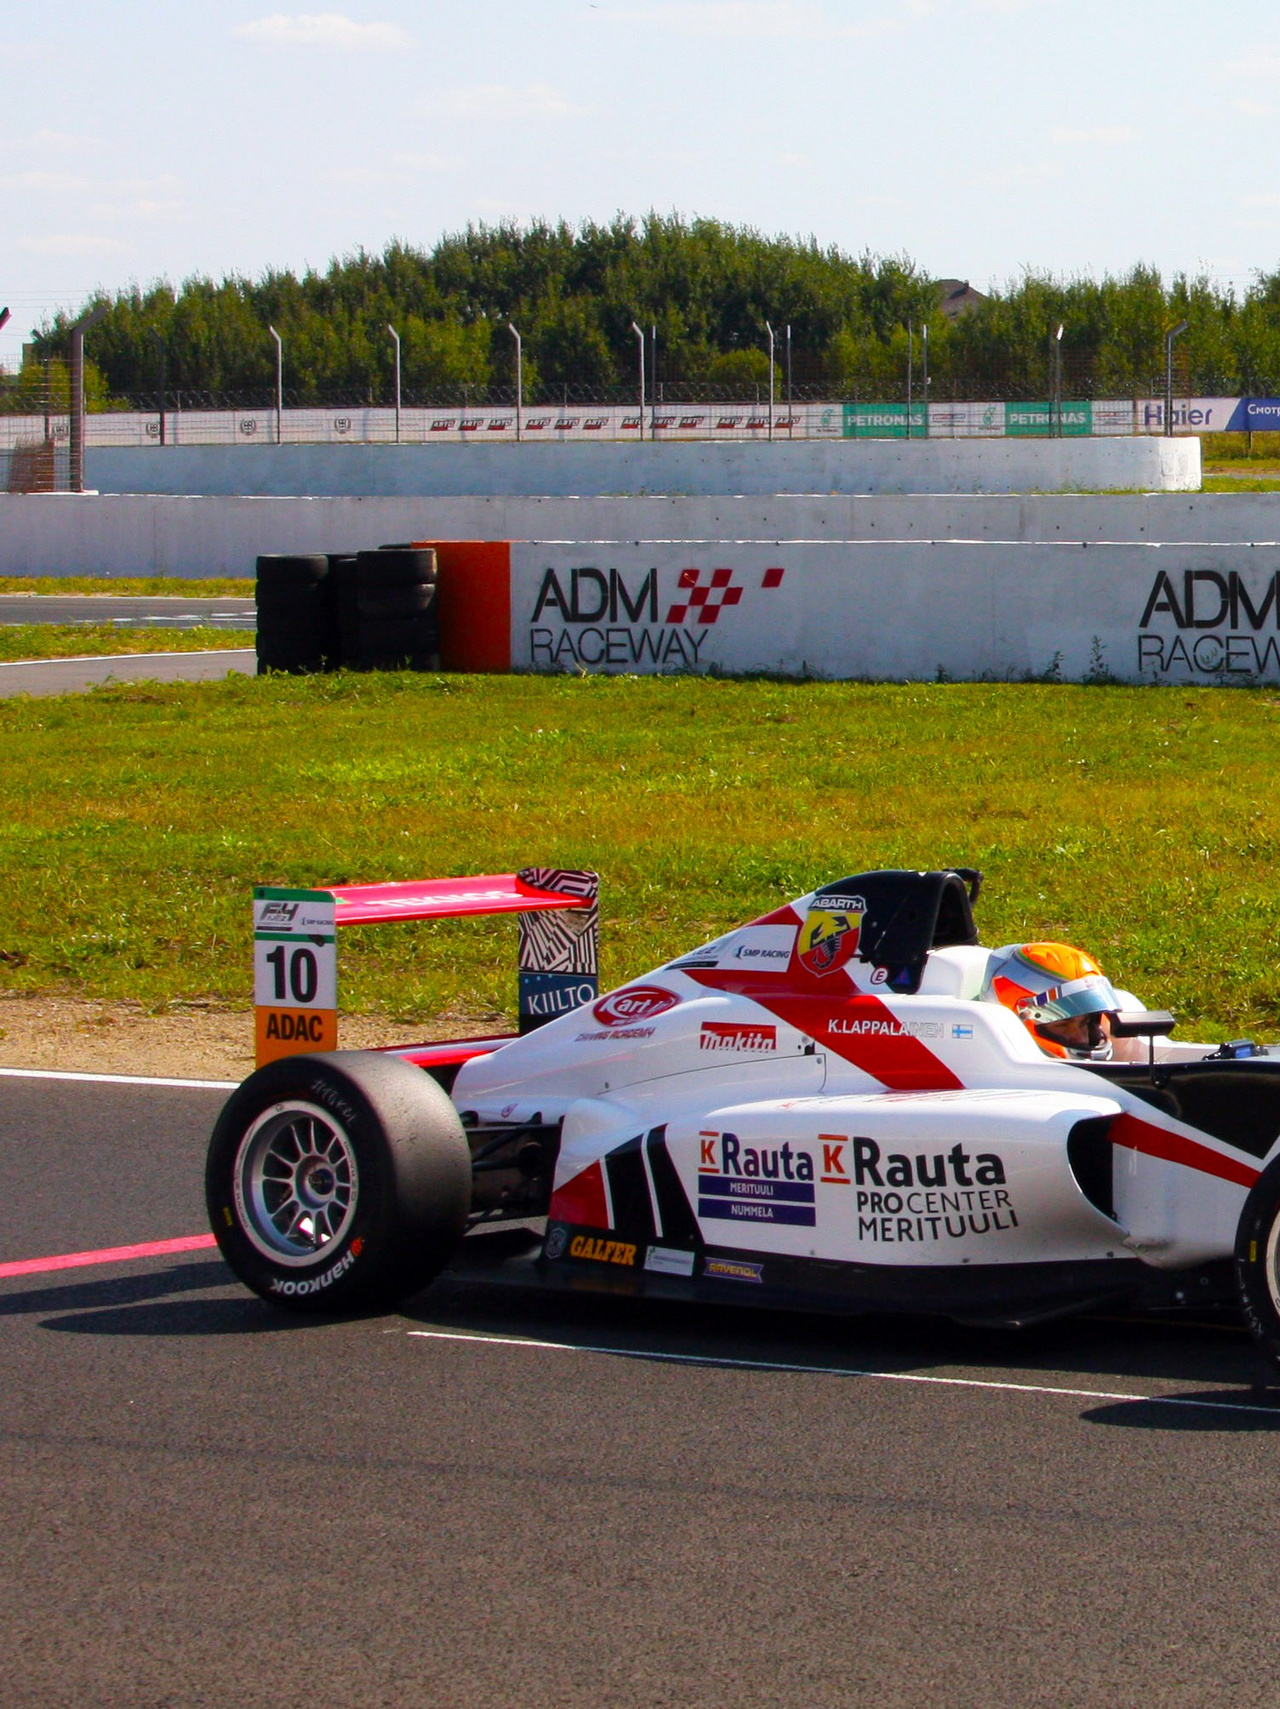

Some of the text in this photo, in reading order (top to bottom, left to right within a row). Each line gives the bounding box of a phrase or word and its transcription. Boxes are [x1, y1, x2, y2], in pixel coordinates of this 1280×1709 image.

[1145, 404, 1213, 426] Haier
[530, 568, 658, 623] ADM
[530, 628, 709, 664] RACEWAY
[811, 898, 862, 909] ABARTH
[743, 948, 791, 959] SMP RACING
[266, 945, 318, 1003] 10
[528, 983, 596, 1015] KIILTO
[598, 990, 659, 1019] Kart
[266, 1013, 323, 1042] ADAC
[828, 1019, 944, 1039] K.LAPPALAINEN
[700, 1132, 815, 1181] K Rauta
[823, 1136, 1007, 1188] K Rauta
[730, 1182, 774, 1197] MERITUULI
[857, 1189, 1013, 1215] PROCENTER
[731, 1203, 774, 1219] NUMMELA
[858, 1209, 1019, 1242] MERITUULI
[570, 1235, 637, 1266] GALFER
[709, 1262, 758, 1278] RAVENOL
